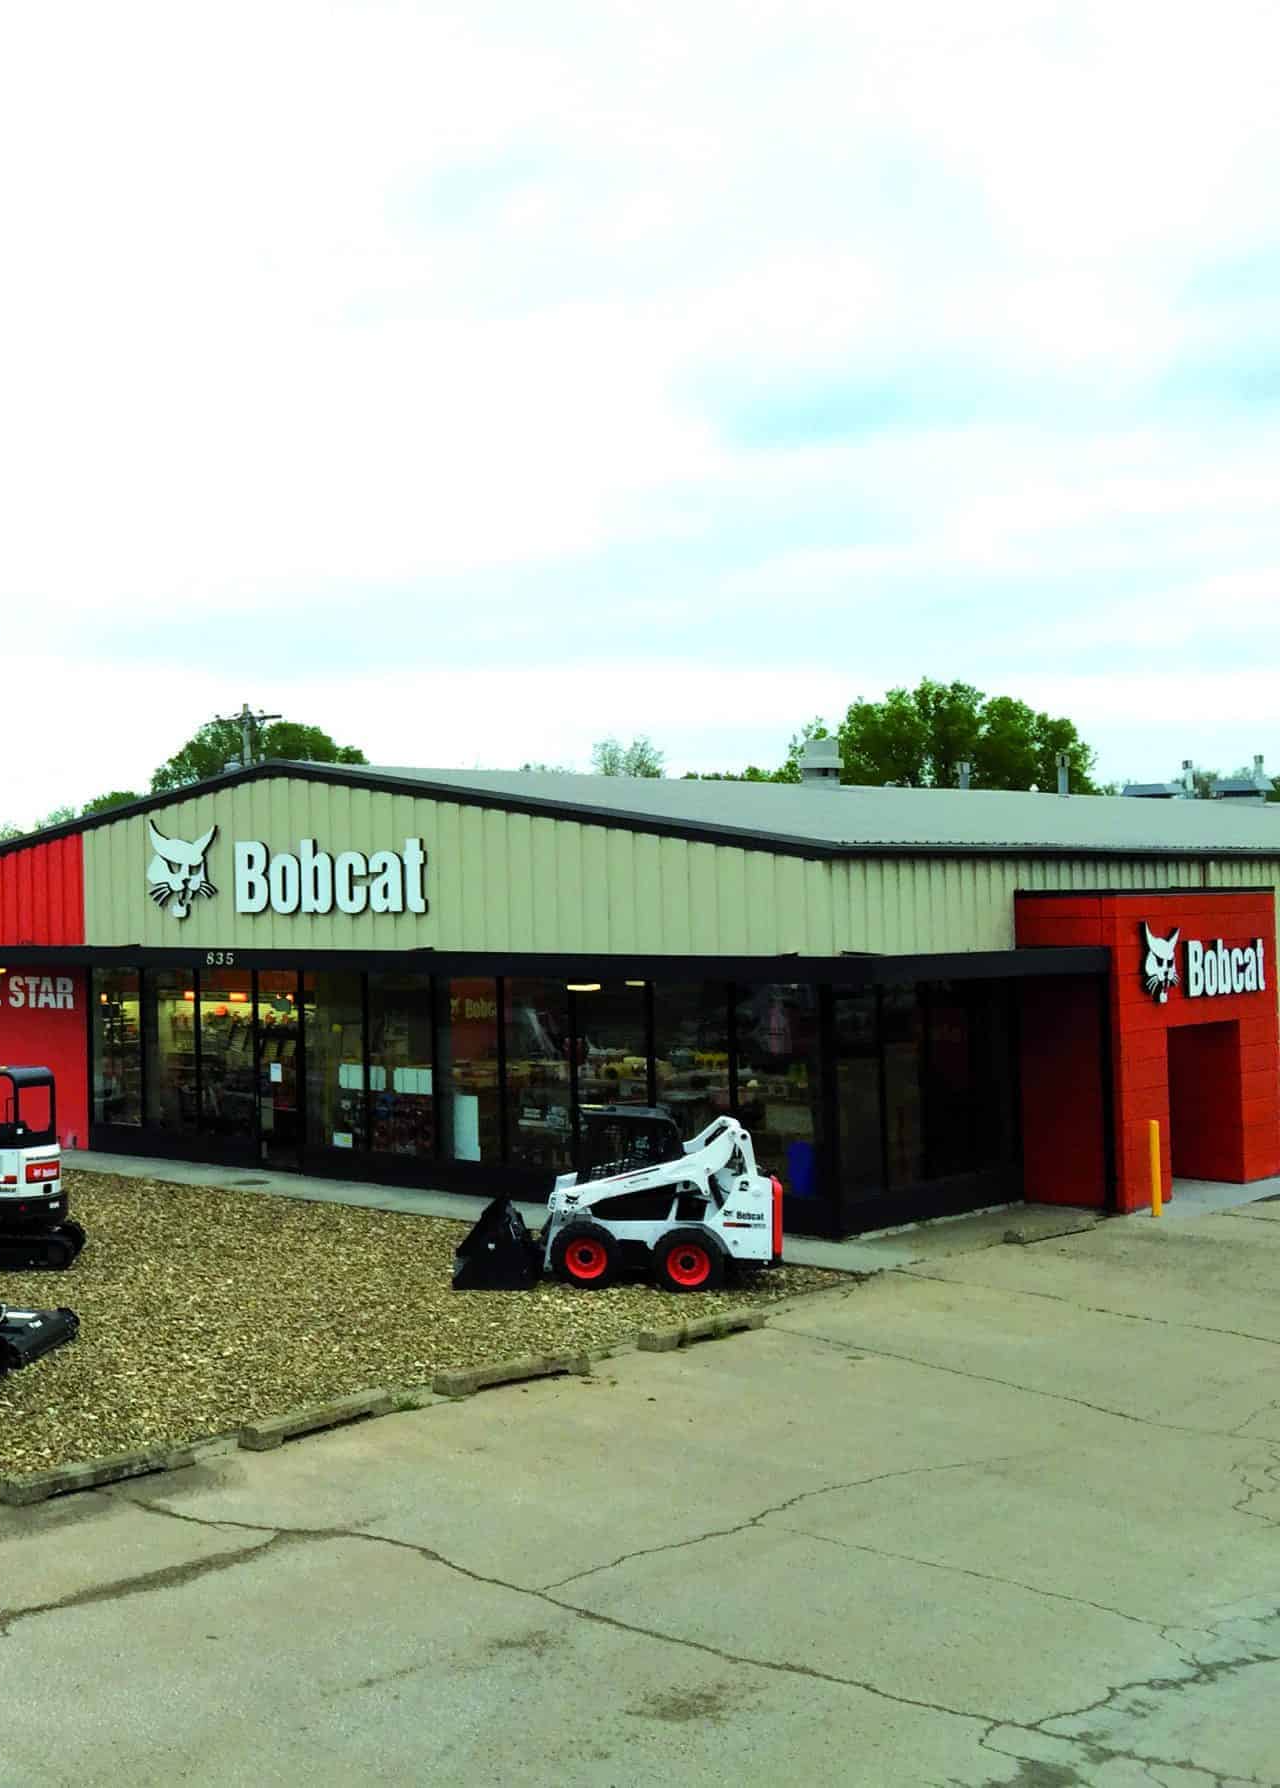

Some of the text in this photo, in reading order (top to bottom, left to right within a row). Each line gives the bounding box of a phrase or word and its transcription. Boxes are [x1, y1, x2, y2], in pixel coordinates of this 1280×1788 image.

[234, 838, 427, 914] Bobcat
[205, 951, 235, 966] 835
[1188, 938, 1266, 997] Bobcat
[8, 975, 75, 1009] STAR
[736, 1210, 765, 1222] Bobcat
